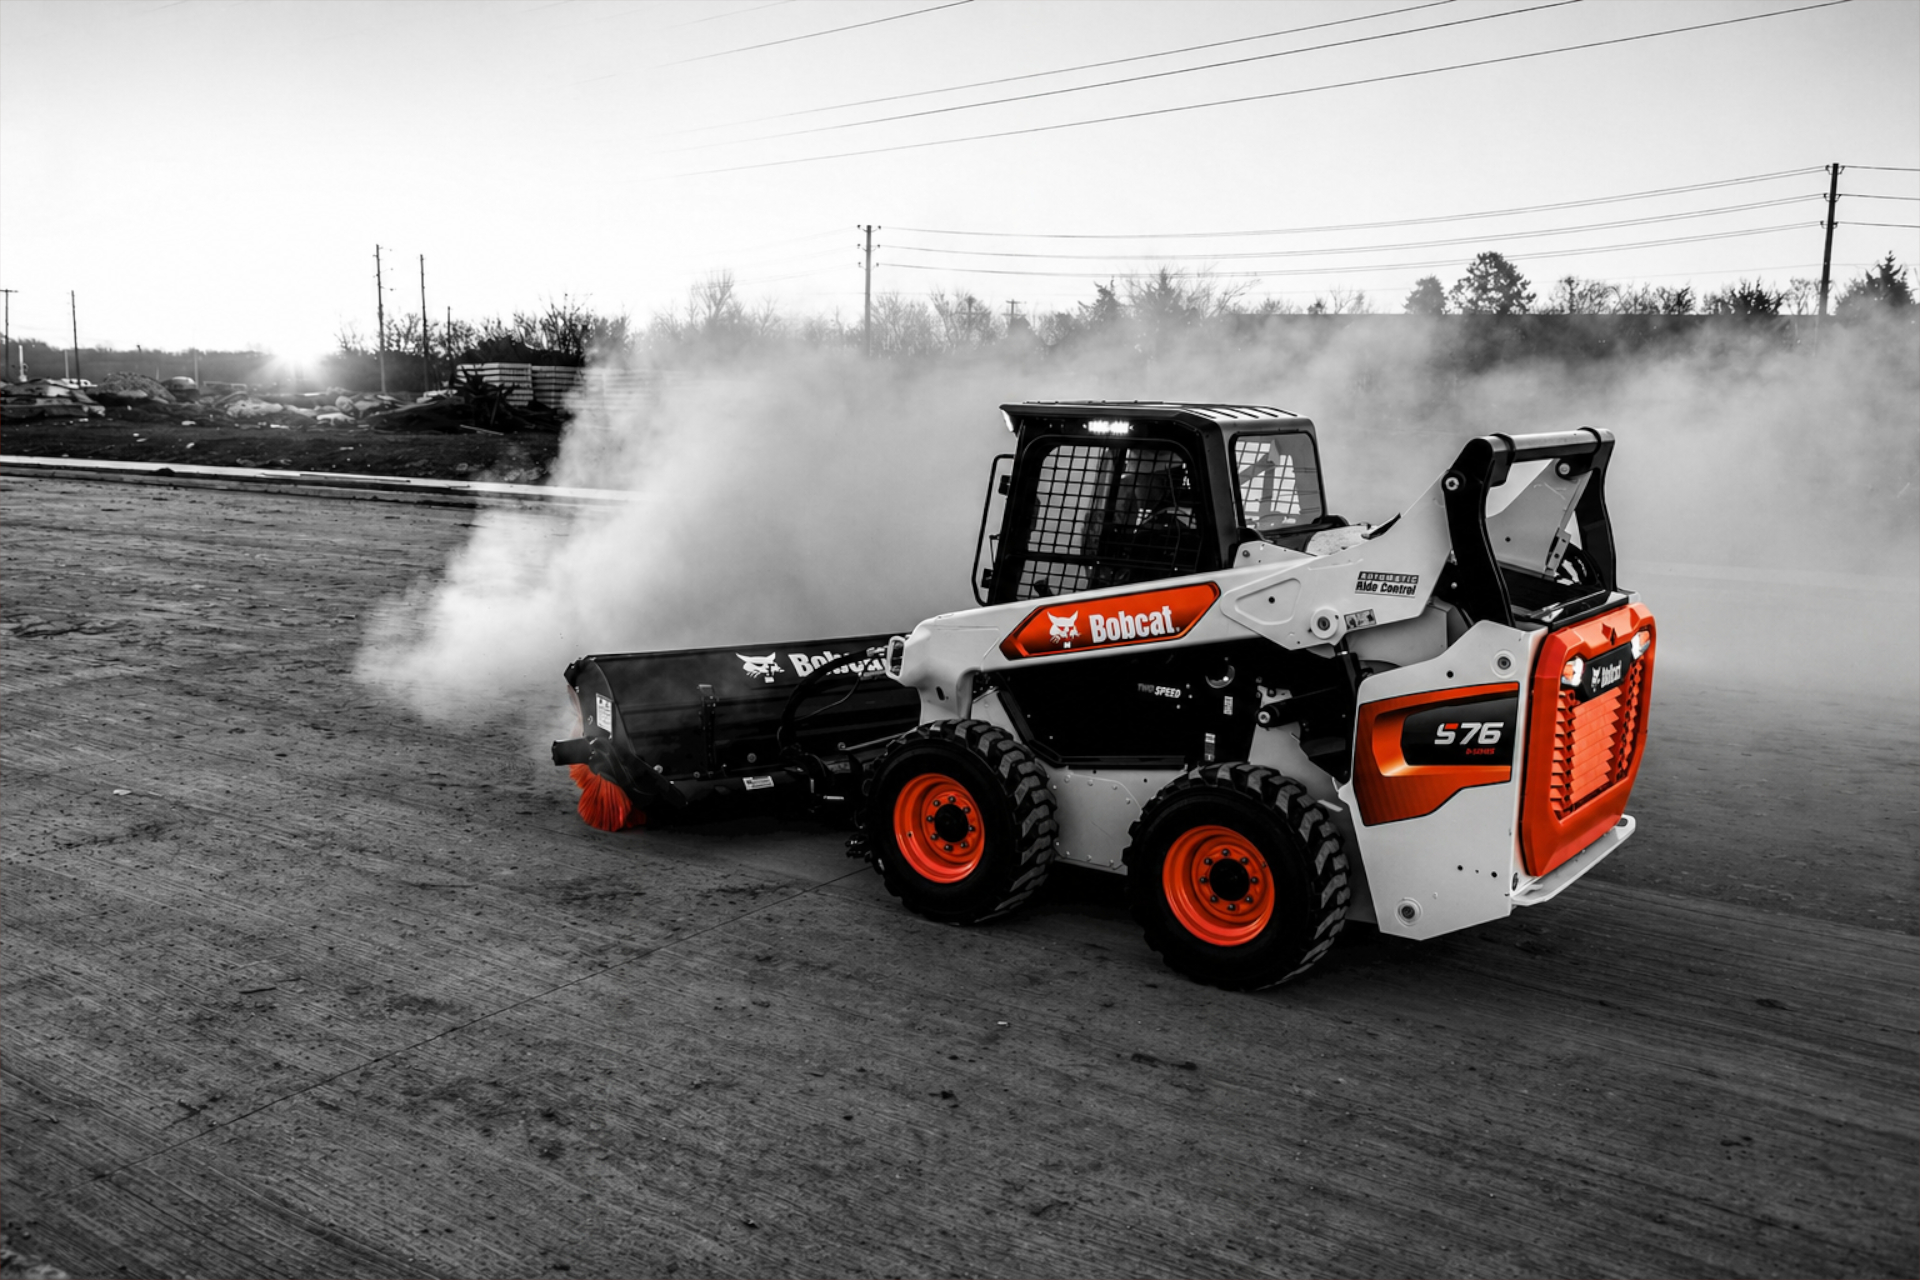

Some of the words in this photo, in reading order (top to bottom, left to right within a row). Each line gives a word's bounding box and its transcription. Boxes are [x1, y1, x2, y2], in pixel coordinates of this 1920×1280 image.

[1380, 582, 1417, 595] Control
[1089, 606, 1178, 644] Bobcat
[1154, 685, 1182, 698] SPEED
